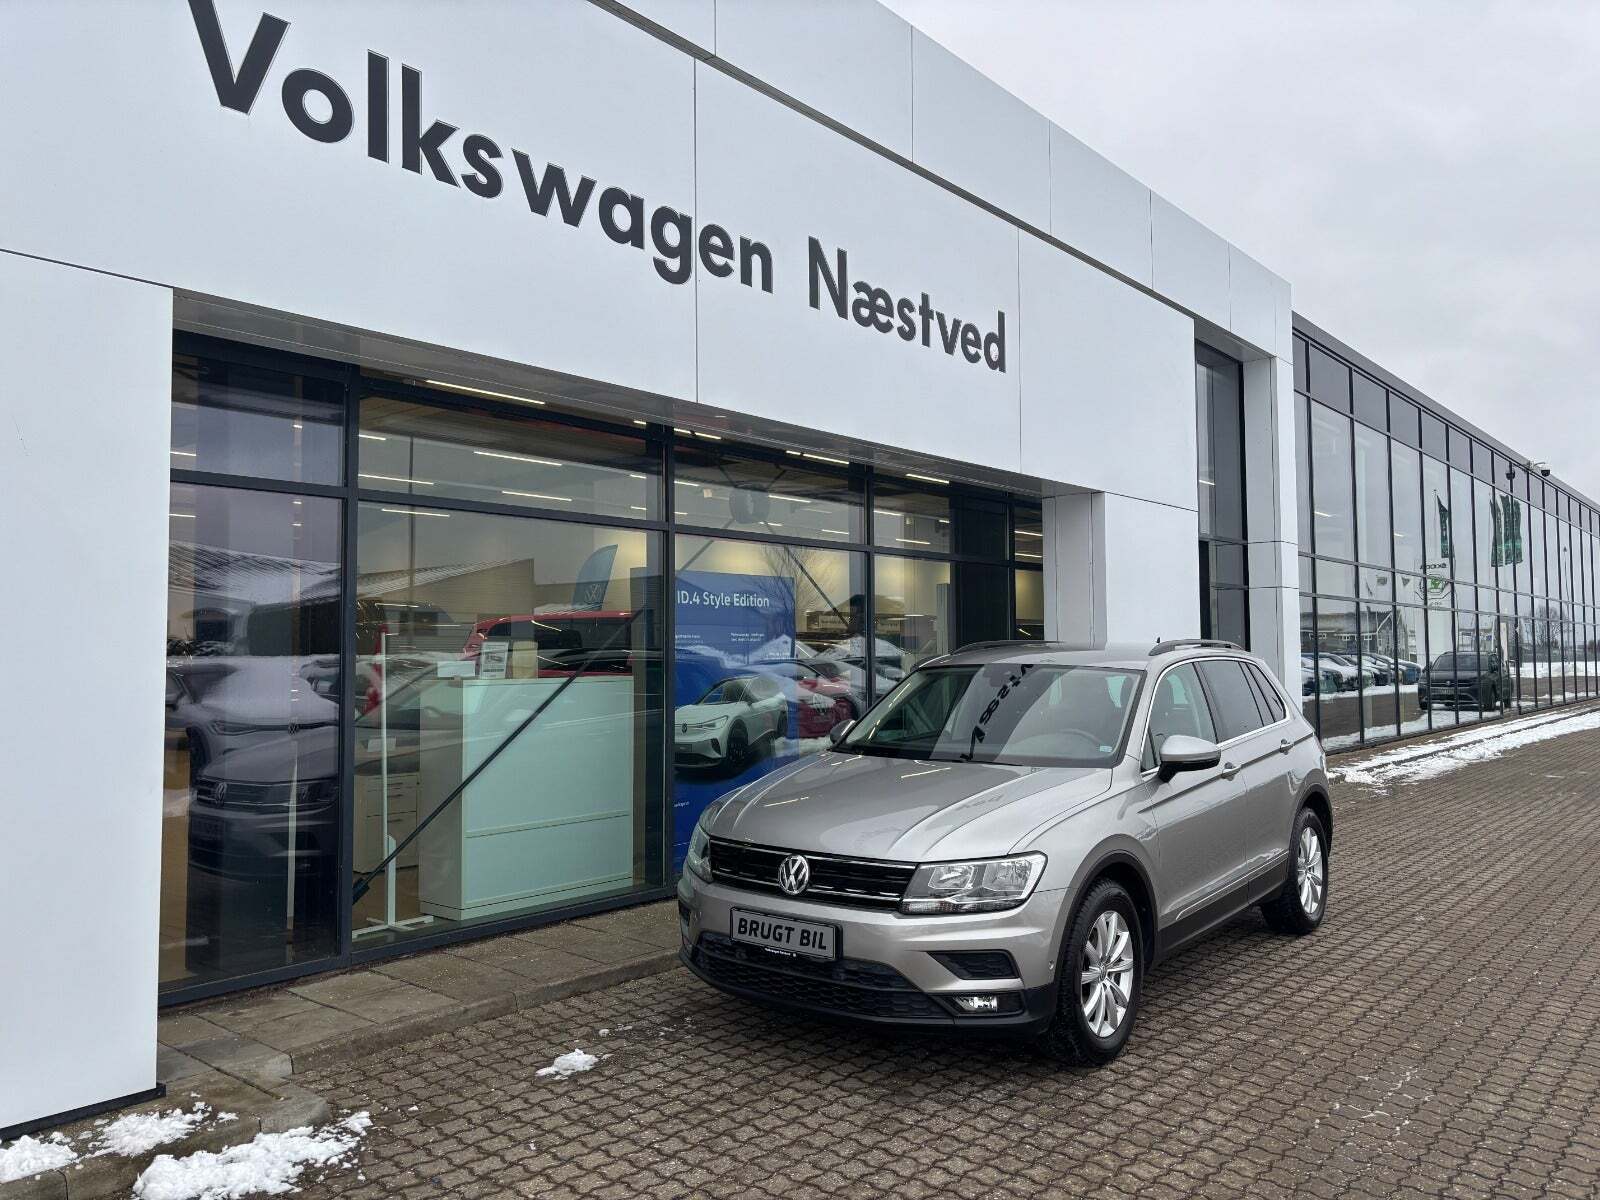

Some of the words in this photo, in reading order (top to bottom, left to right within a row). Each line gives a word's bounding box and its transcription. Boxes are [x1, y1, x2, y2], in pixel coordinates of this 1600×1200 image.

[189, 0, 774, 294] Volkswagen
[808, 235, 1006, 373] Næstved
[677, 590, 700, 605] ID.4
[703, 591, 731, 609] Style
[733, 593, 770, 608] Edition
[738, 918, 795, 944] BRUGT
[799, 929, 827, 951] BIL
